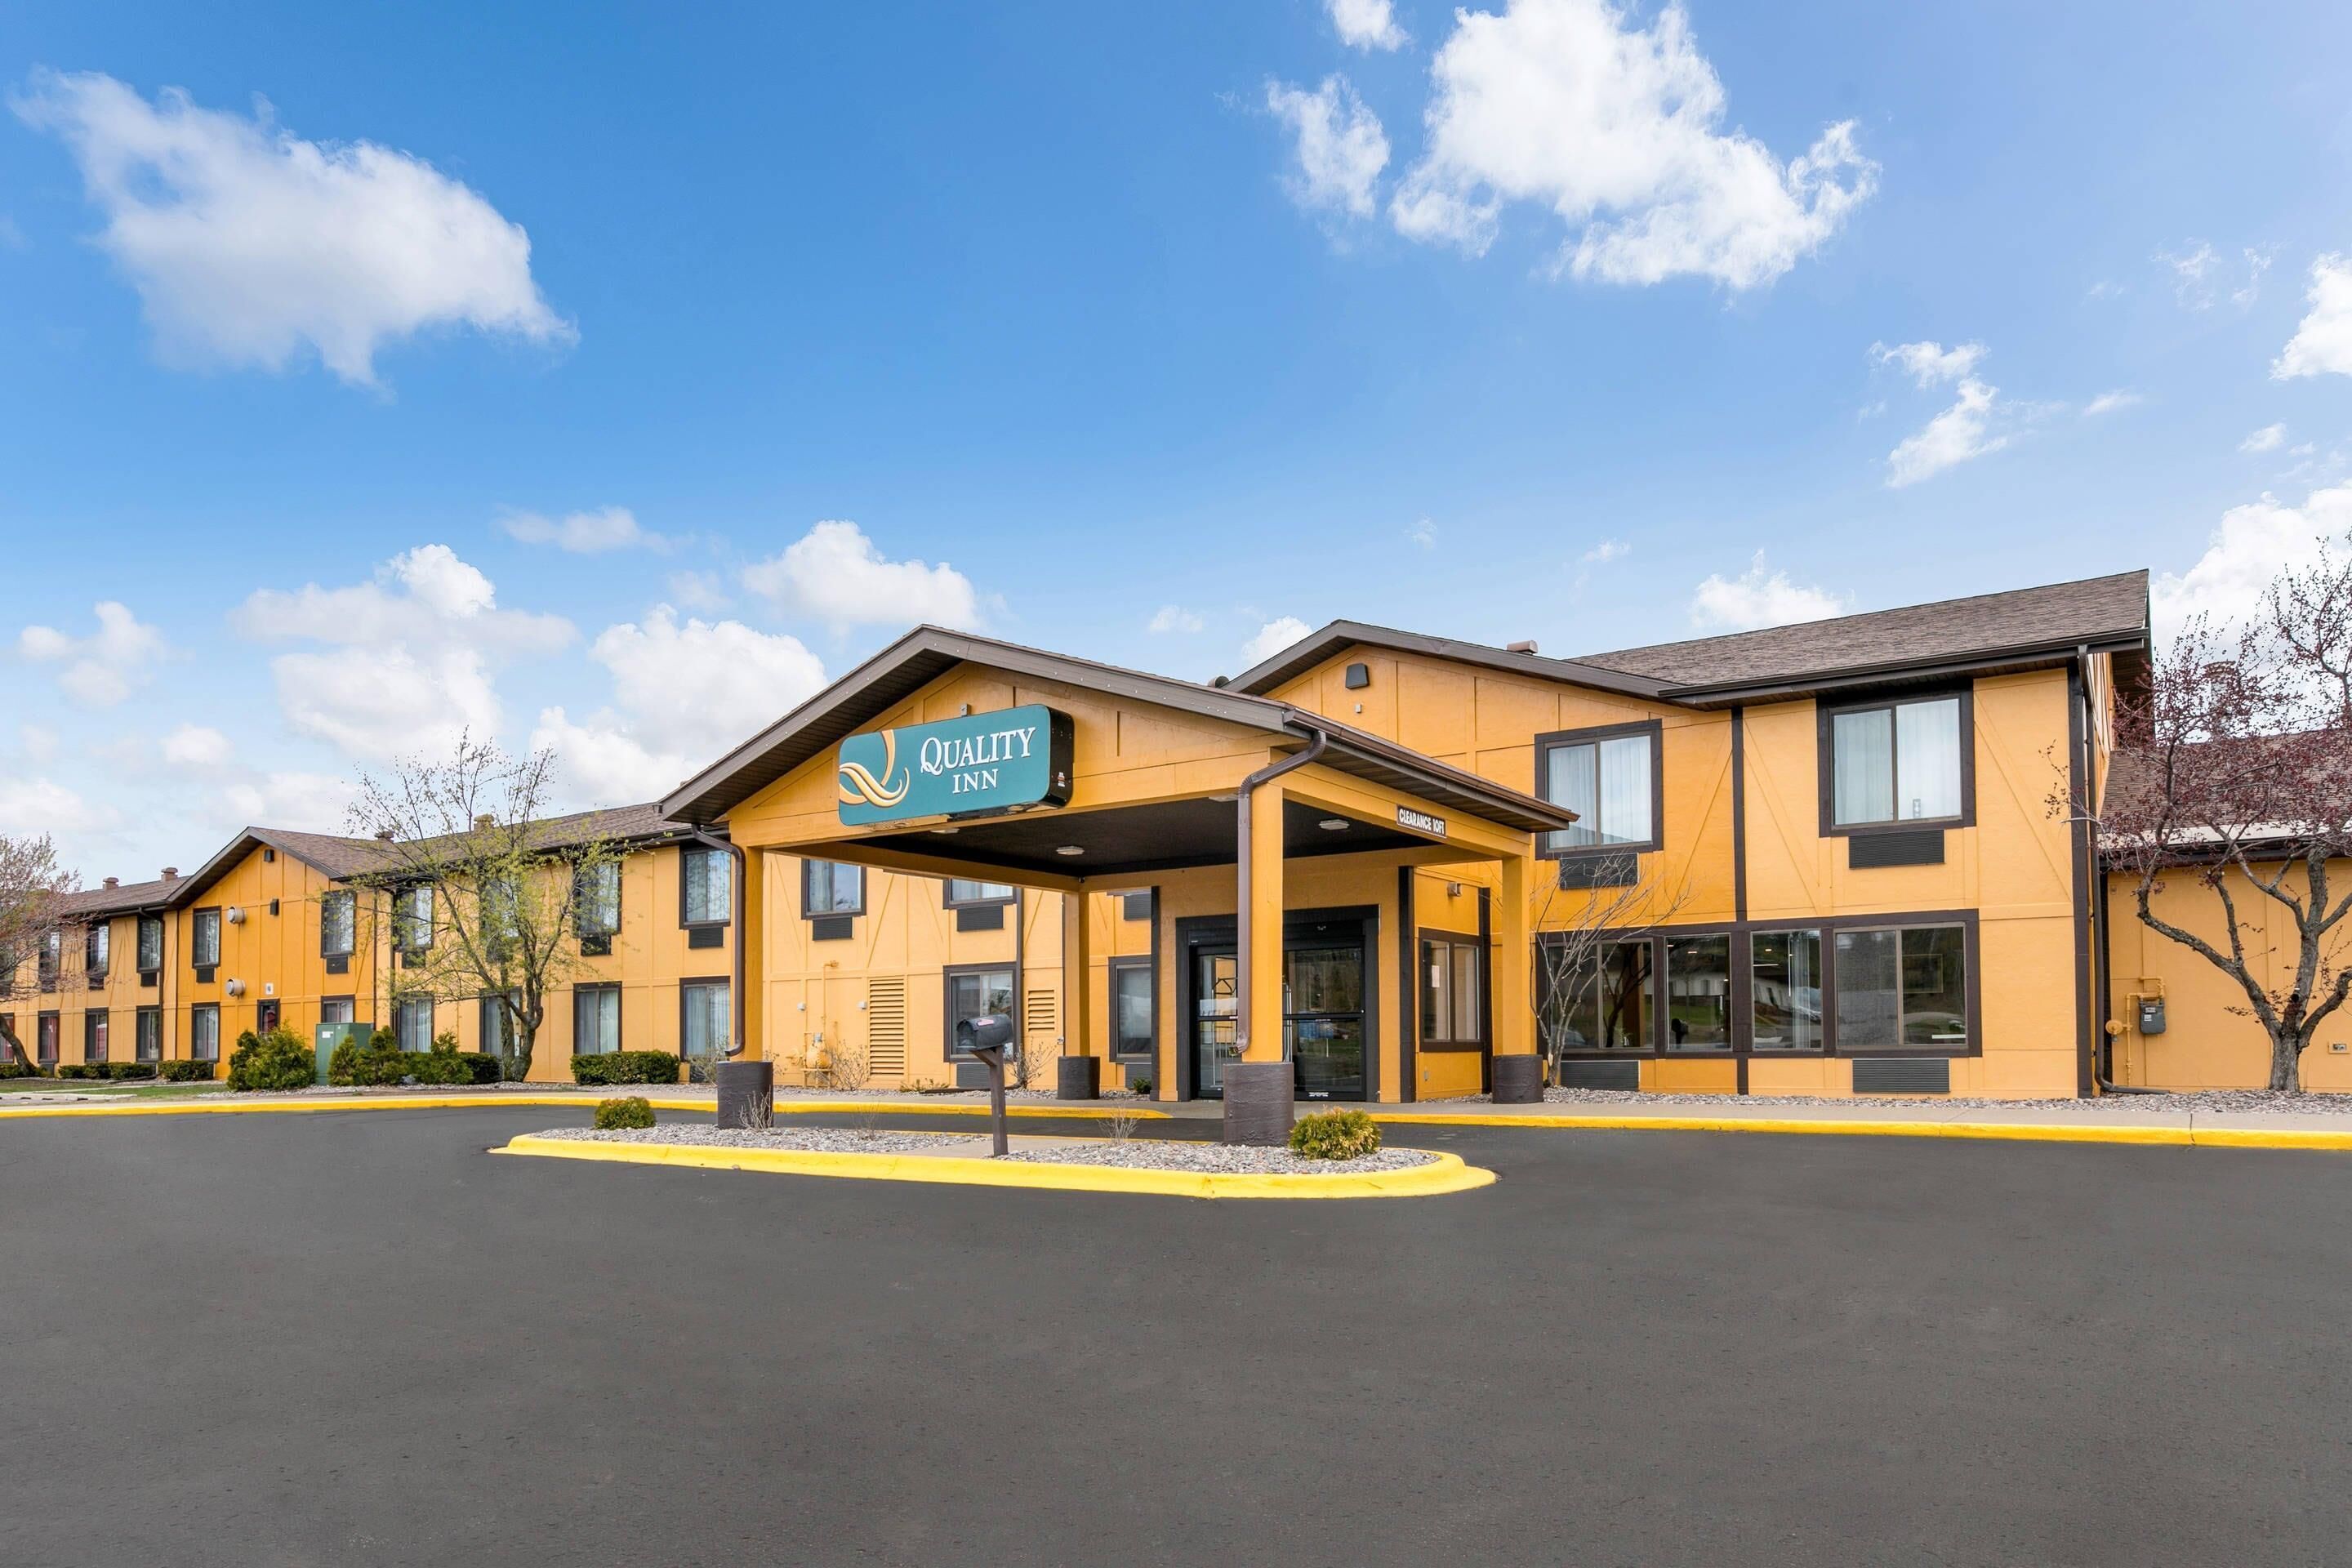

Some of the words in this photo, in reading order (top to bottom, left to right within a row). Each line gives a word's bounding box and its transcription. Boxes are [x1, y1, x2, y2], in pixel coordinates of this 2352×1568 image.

[920, 727, 1036, 776] QUALITY
[952, 768, 999, 794] INN
[1399, 808, 1432, 831] CLEARANCE
